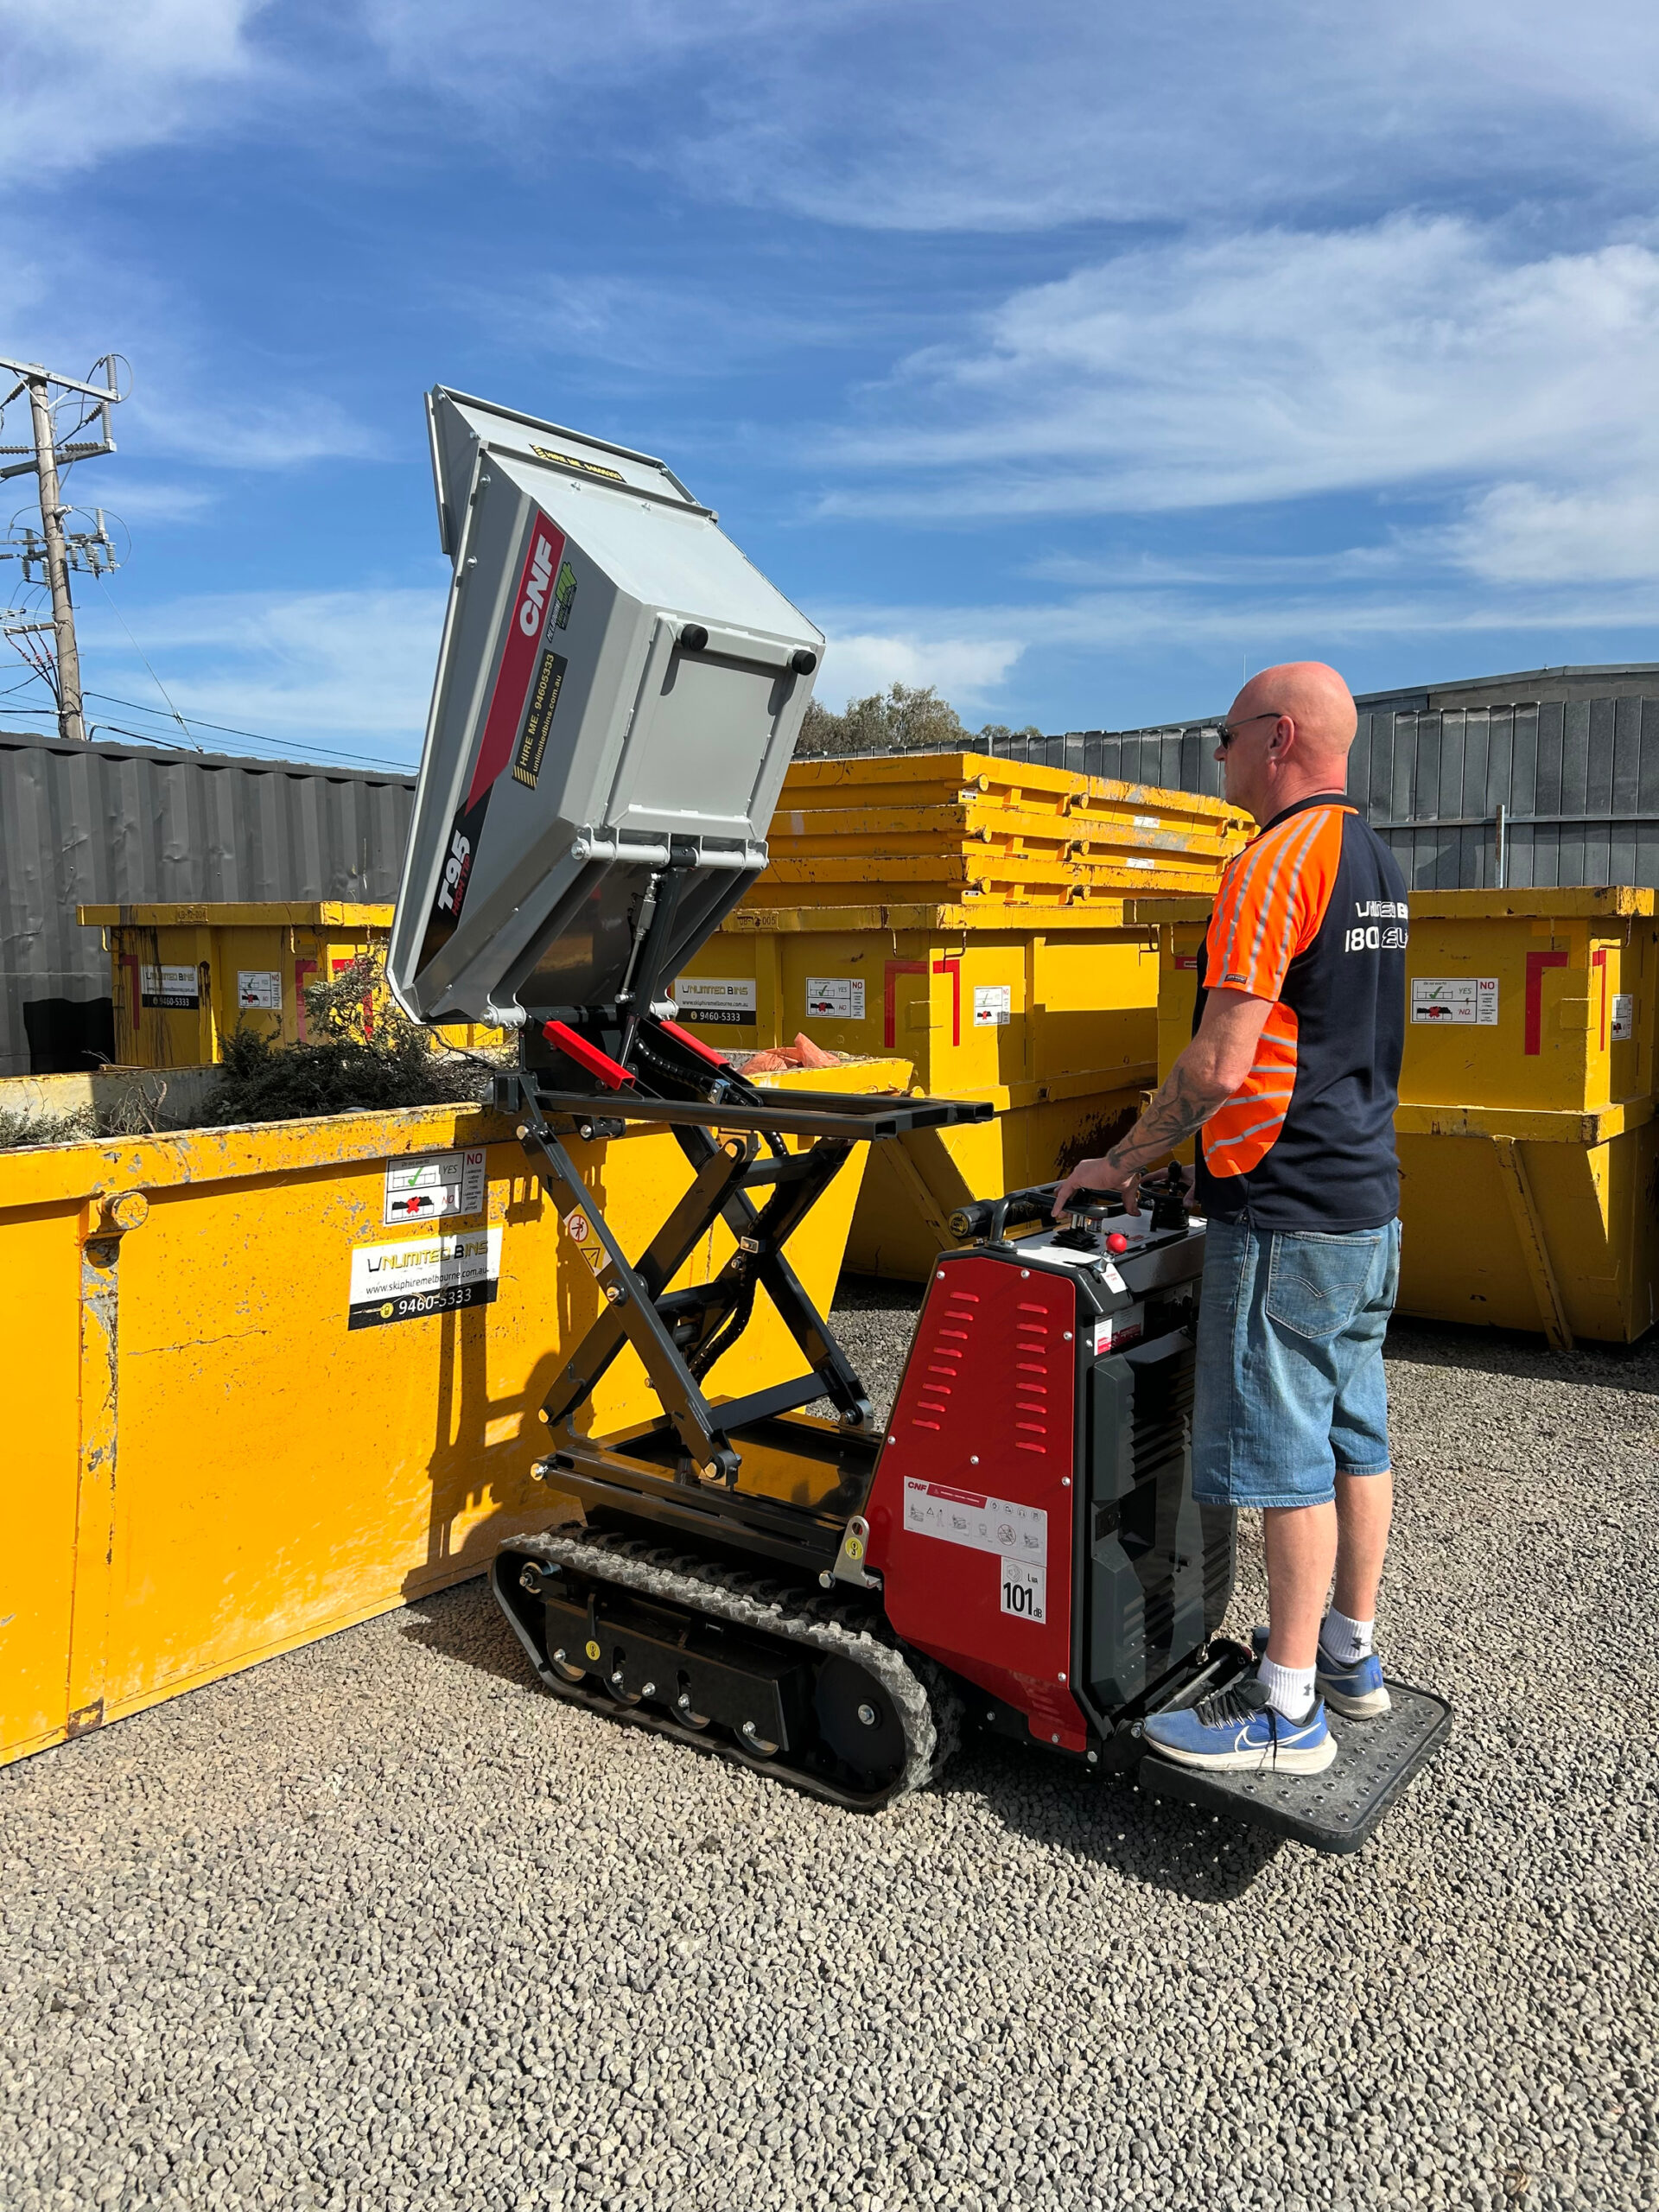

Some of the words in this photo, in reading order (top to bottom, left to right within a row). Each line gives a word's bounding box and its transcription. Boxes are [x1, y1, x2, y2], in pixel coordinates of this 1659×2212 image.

[520, 533, 552, 637] CNF
[519, 735, 533, 766] HIRE
[528, 714, 540, 735] ME.
[534, 653, 554, 710] 94605333
[532, 675, 562, 772] unlimitedbins.com.au
[437, 829, 470, 910] T95
[451, 879, 465, 916] HIGH
[461, 854, 470, 878] TIP
[159, 996, 189, 1007] 9460-5333
[682, 985, 726, 995] UNLIMITED
[727, 986, 748, 995] BINS
[700, 1011, 741, 1021] 9460-5333
[442, 1165, 458, 1174] YES
[467, 1153, 482, 1165] NO
[442, 1195, 454, 1205] NO
[367, 1247, 450, 1273] UNLIMITED
[454, 1241, 488, 1260] BINS
[365, 1267, 487, 1294] www.skiphiremelbourne.com.au
[398, 1287, 472, 1315] 9460-5333
[907, 1481, 927, 1492] CNF
[1003, 1581, 1033, 1616] 101
[1033, 1607, 1042, 1618] dB
